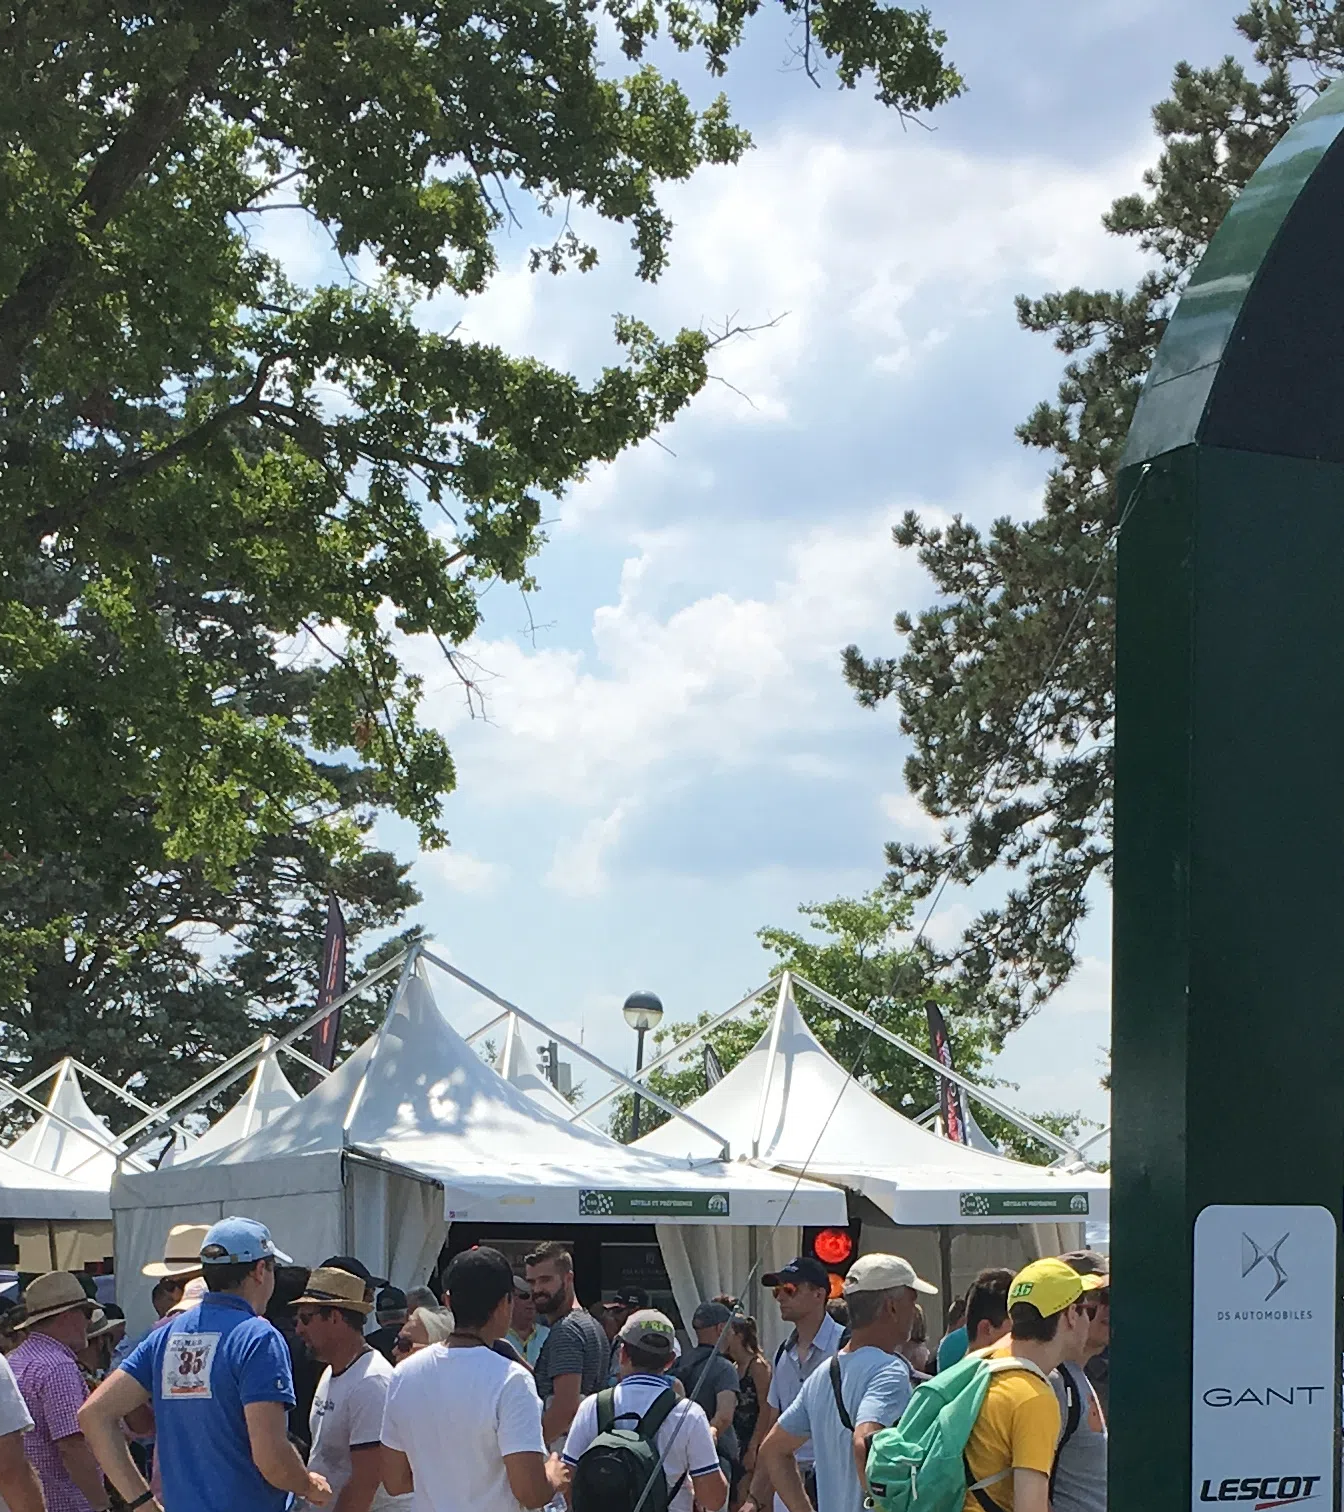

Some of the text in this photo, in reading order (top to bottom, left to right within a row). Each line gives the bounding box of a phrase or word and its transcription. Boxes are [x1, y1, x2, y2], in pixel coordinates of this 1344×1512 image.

[1217, 1310, 1313, 1321] DS AUTOMOBILES
[1202, 1386, 1325, 1408] GANT
[1199, 1475, 1322, 1502] LESCOT
